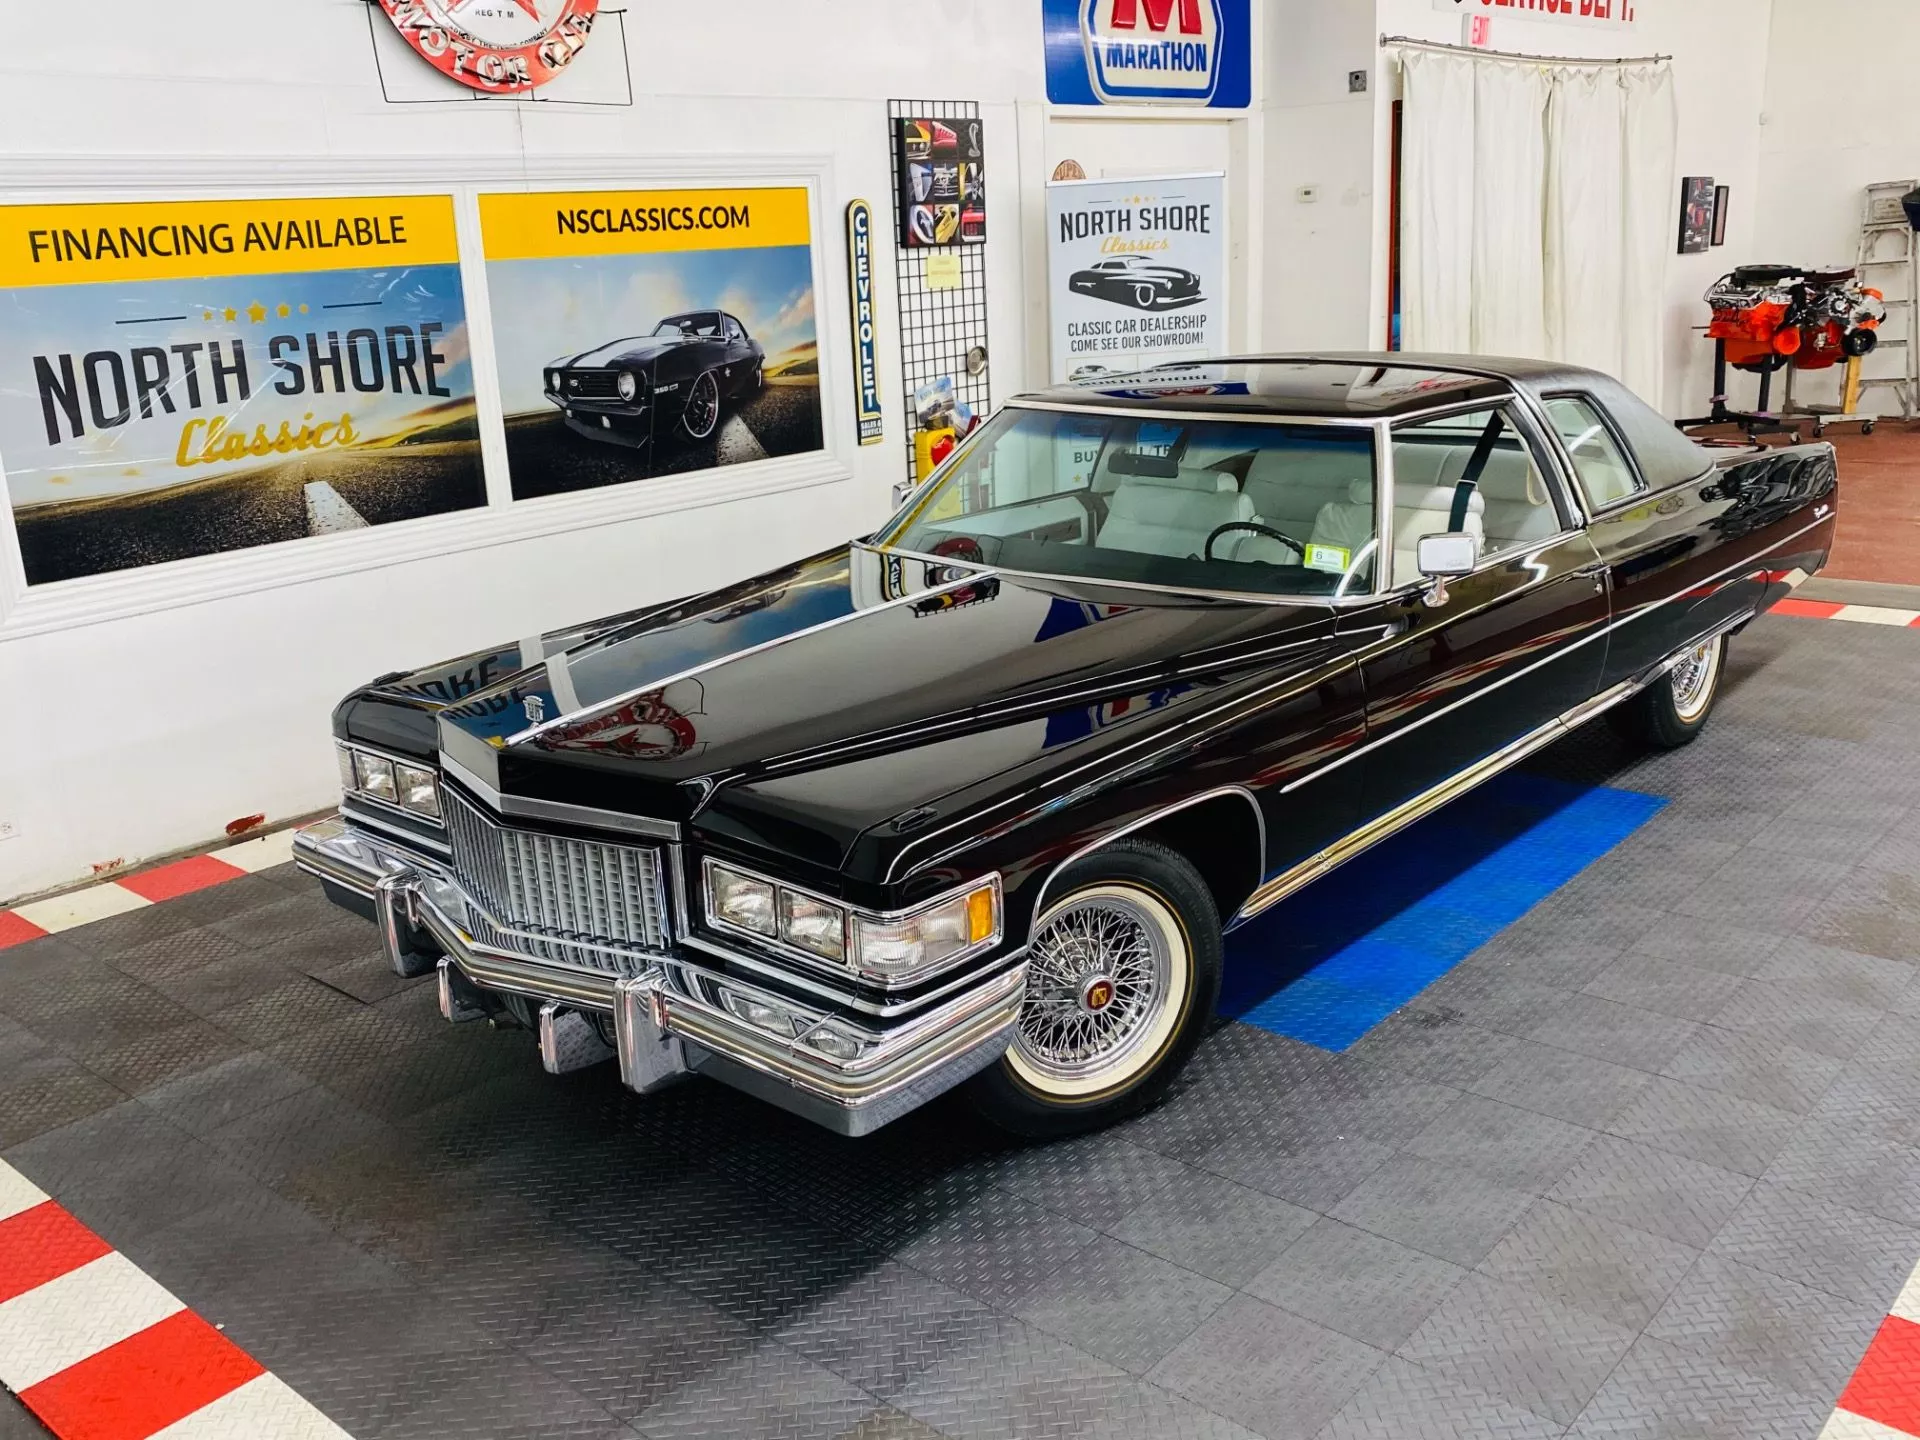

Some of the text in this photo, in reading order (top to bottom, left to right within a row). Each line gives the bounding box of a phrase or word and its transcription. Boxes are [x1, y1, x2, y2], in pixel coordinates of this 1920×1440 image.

[475, 9, 493, 17] REG
[507, 11, 514, 19] M
[1106, 40, 1207, 72] MARATHON
[556, 205, 750, 235] NSCLASSICS.COM
[1060, 204, 1210, 244] NORTH SHORE
[29, 215, 408, 263] FINANCING AVAILABLE
[1100, 236, 1170, 254] Classics
[854, 212, 874, 409] CHEVROLET
[1068, 314, 1207, 337] CLASSIC CAR DEALERSHIP
[1071, 331, 1204, 353] COME SEE OUR SHOWROOM!
[33, 323, 451, 447] NORTH SHORE
[175, 412, 361, 467] Classics
[1316, 551, 1323, 560] 6
